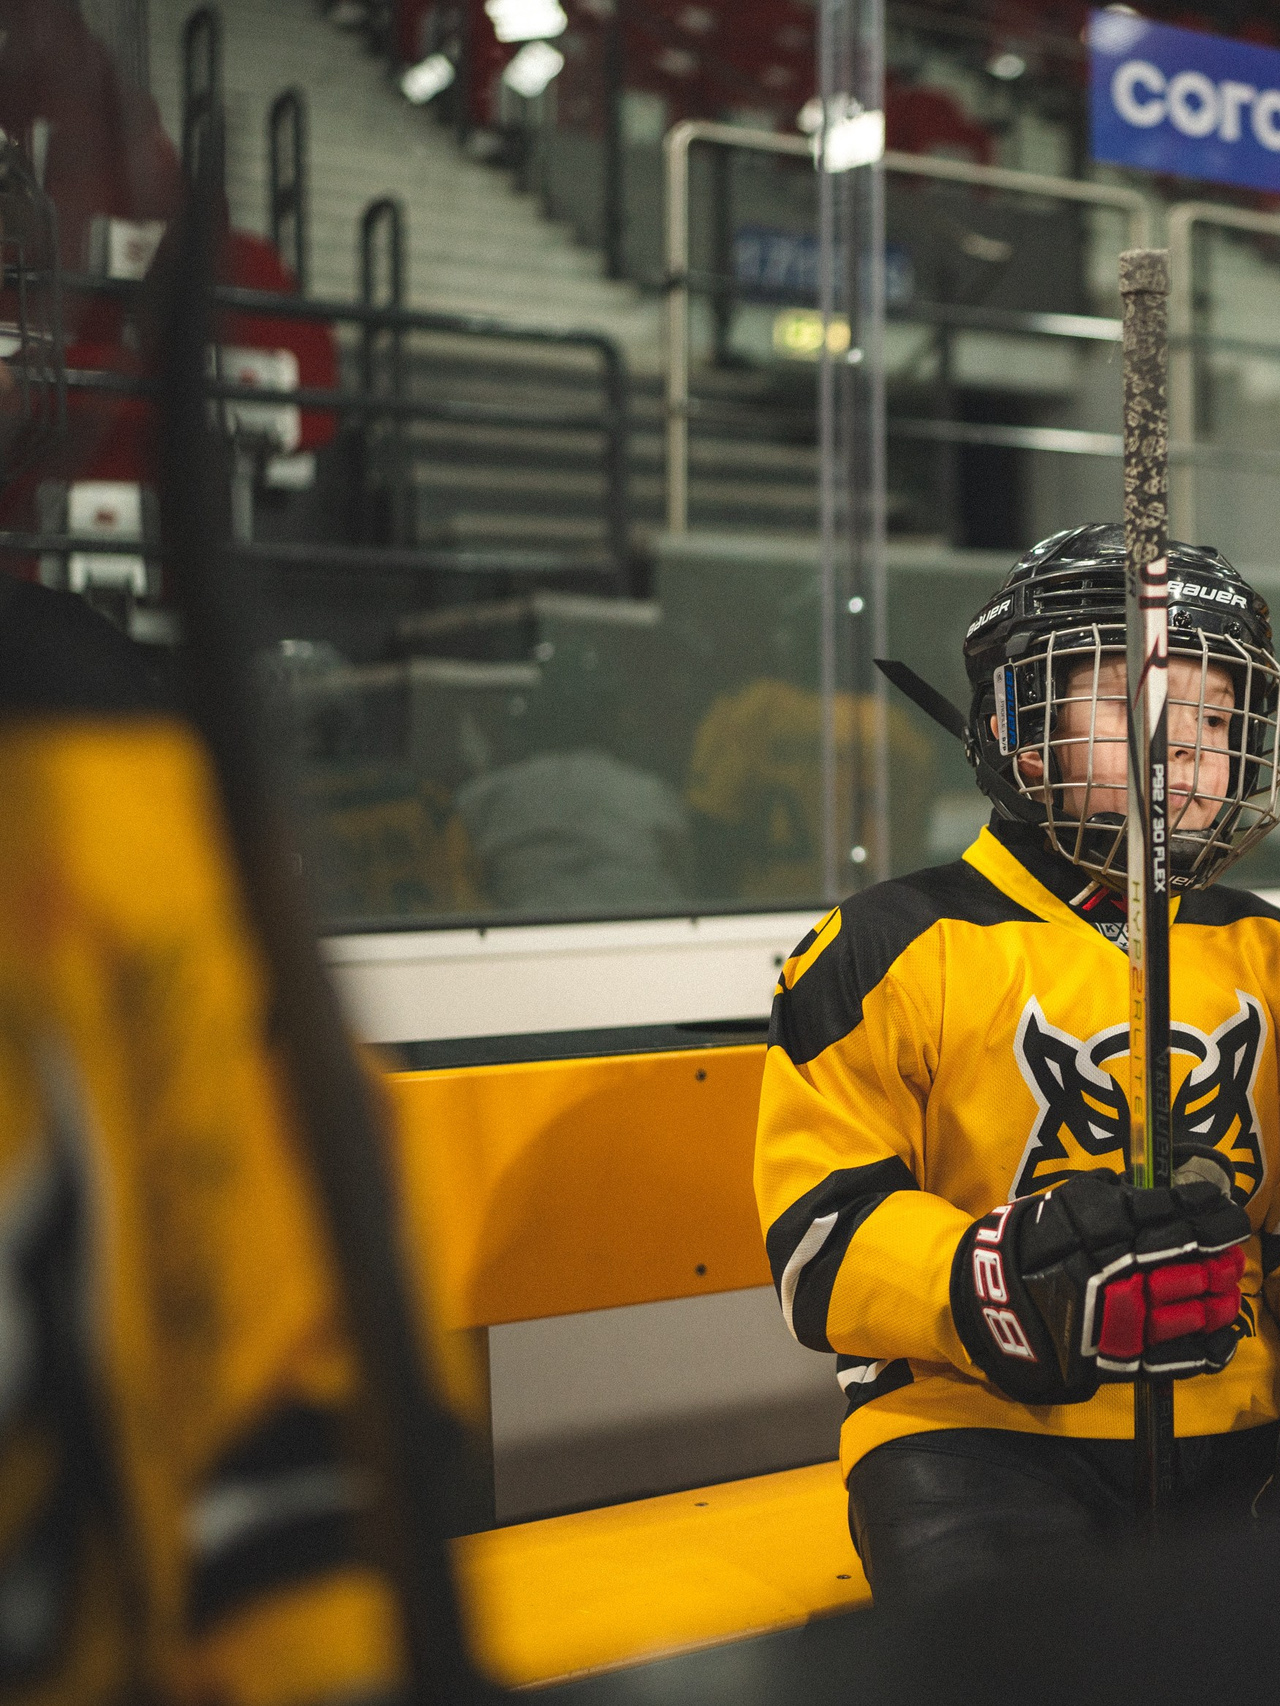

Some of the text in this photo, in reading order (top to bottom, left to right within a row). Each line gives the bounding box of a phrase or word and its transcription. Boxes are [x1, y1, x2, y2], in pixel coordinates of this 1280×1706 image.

[1152, 763, 1165, 801] P92
[1153, 817, 1165, 843] 30
[1153, 846, 1166, 893] FLEX
[972, 1201, 1038, 1363] BAU
